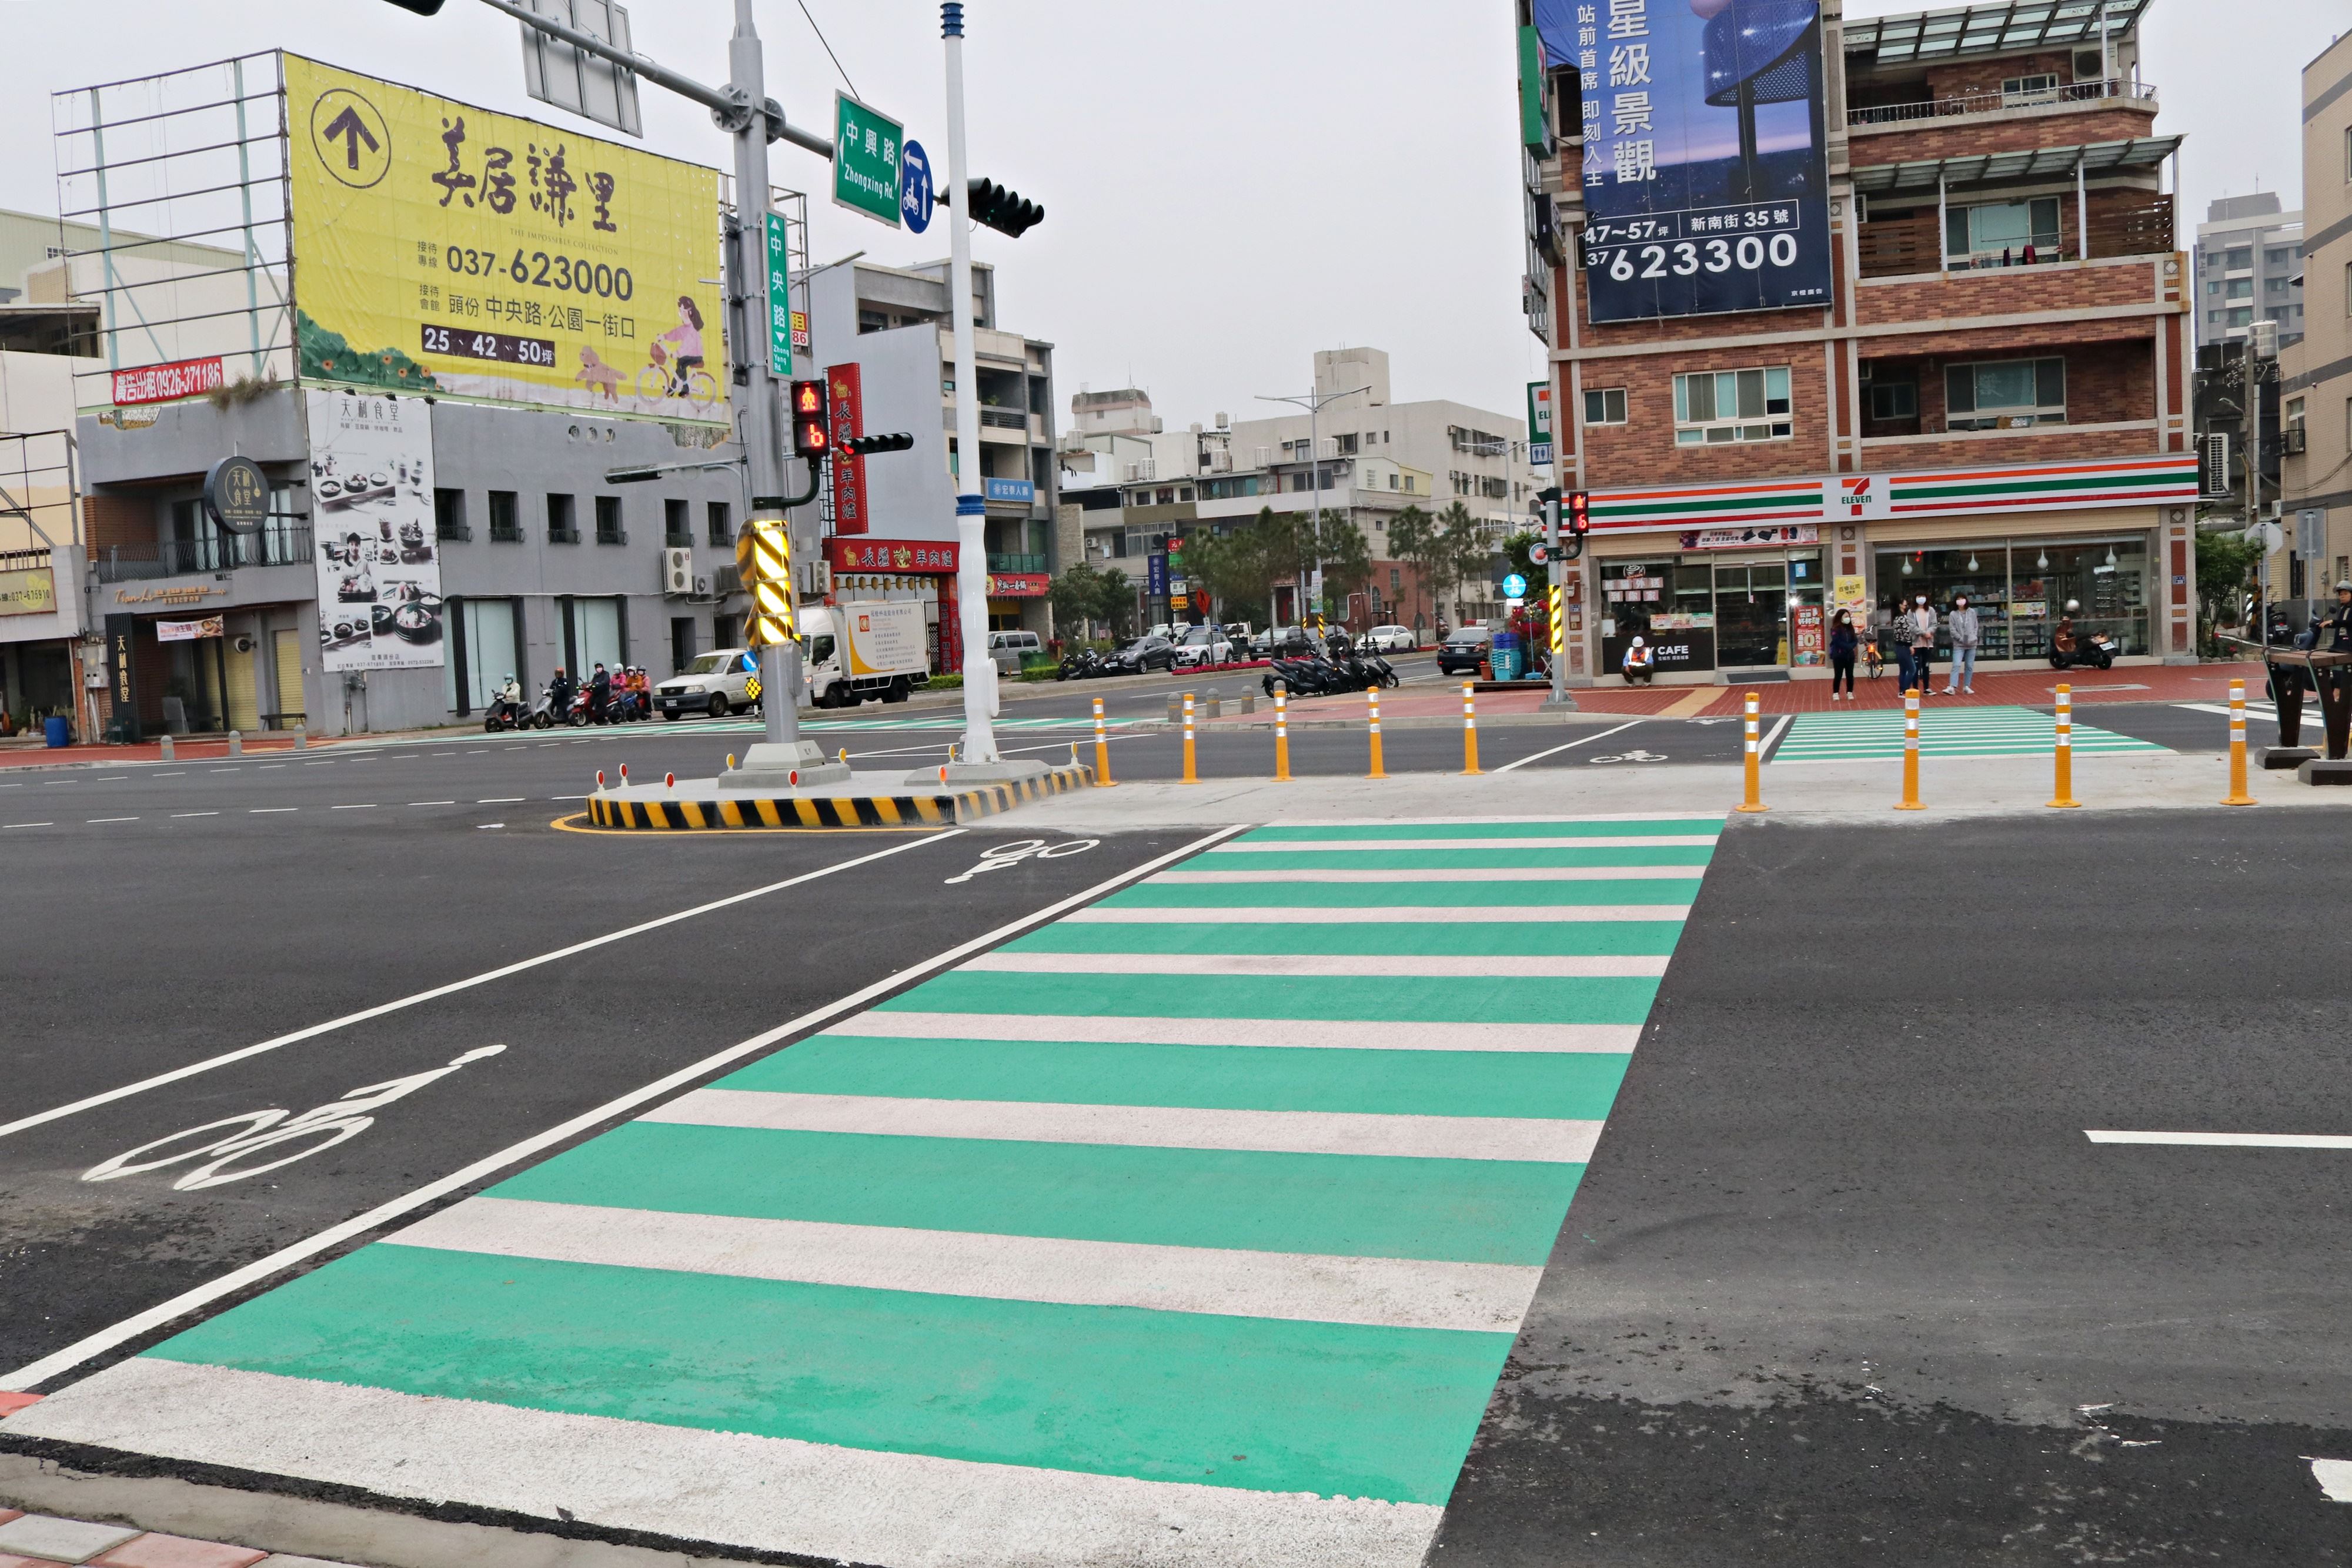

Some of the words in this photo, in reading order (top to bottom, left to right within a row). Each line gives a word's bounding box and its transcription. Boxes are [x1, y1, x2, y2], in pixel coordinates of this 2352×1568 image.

[1577, 4, 1598, 91] 站前首席
[1607, 0, 1656, 183] 星級景觀
[846, 120, 896, 167] 中興路
[1582, 100, 1604, 187] 即刻入主
[845, 163, 883, 199] Zhongxing
[884, 185, 895, 200] Rd.
[1690, 213, 1739, 232] 新南街
[1744, 210, 1769, 228] 35
[1773, 209, 1789, 223] 號
[417, 240, 437, 255] 接待
[510, 228, 524, 236] THE
[527, 232, 571, 246] IMPOSSIBLE
[573, 240, 619, 255] COLLECTION
[418, 255, 438, 269] 專線
[1610, 233, 1797, 282] 623300
[447, 246, 633, 301] 037-623000
[771, 235, 786, 329] 中央路
[419, 283, 439, 298] 接待
[420, 298, 440, 312] 會館
[449, 294, 479, 317] 頭份
[773, 345, 790, 357] Zhong
[774, 354, 787, 366] Yang
[774, 363, 782, 372] Rd.
[341, 399, 399, 422] 天利食堂
[1578, 514, 1587, 529] 6
[1658, 645, 1689, 655] CAFE
[118, 635, 129, 702] 天利食堂
